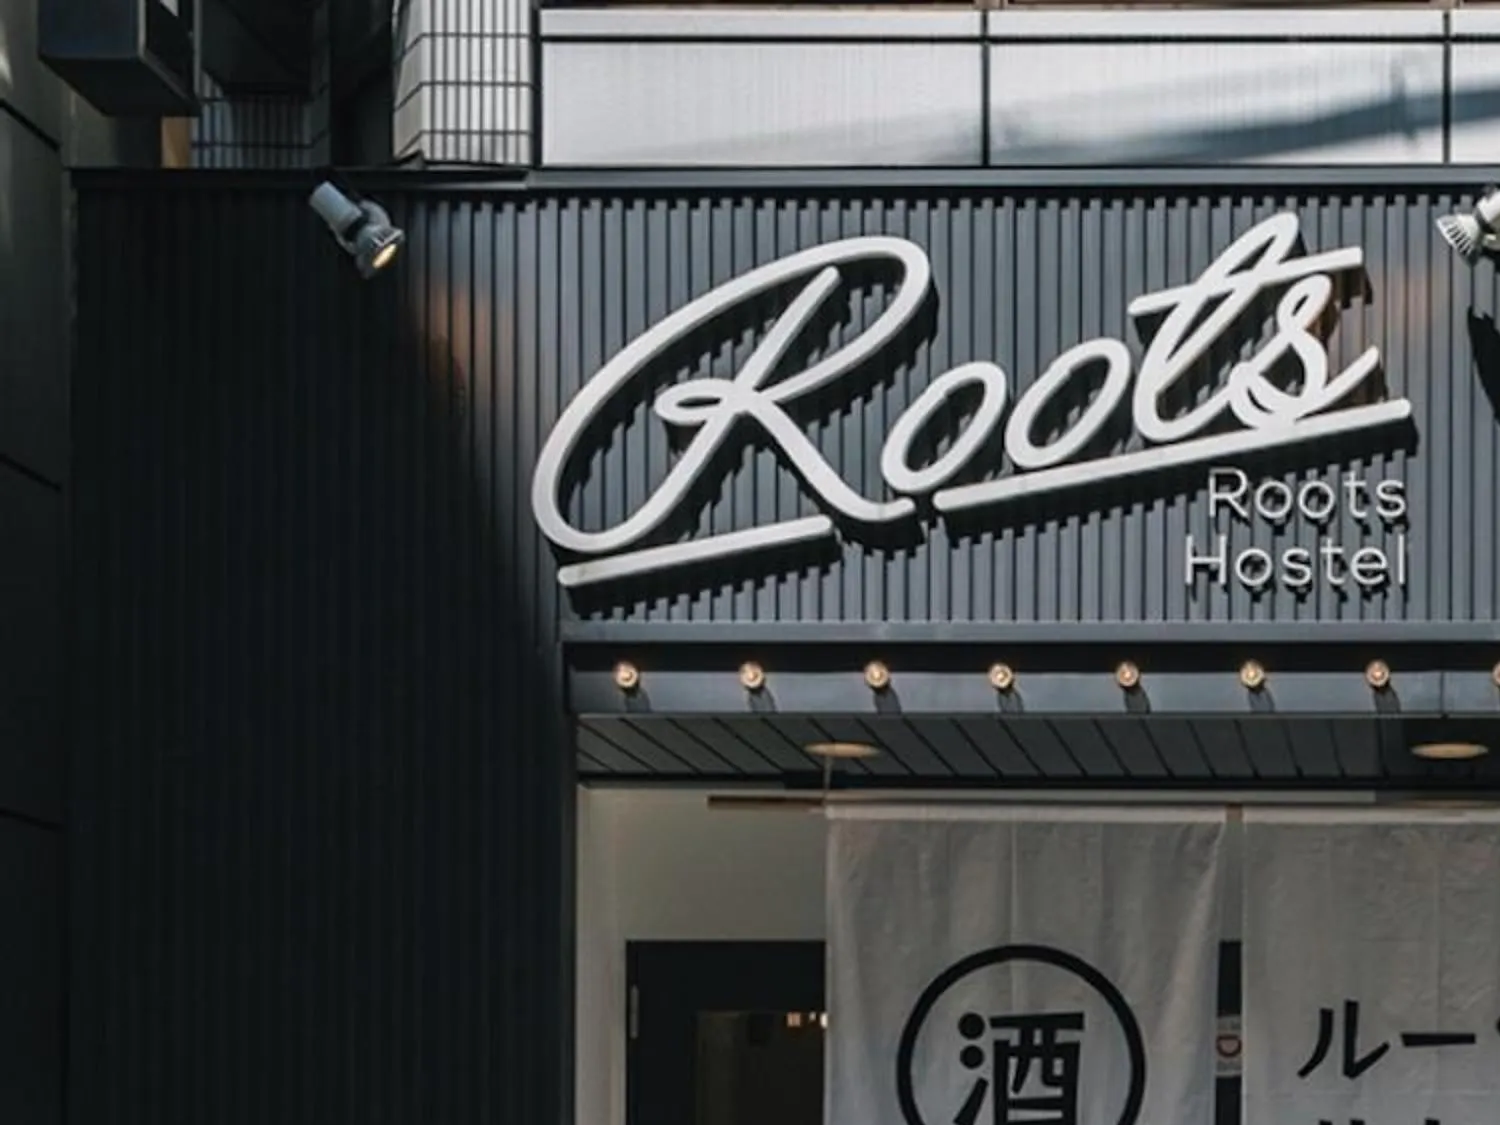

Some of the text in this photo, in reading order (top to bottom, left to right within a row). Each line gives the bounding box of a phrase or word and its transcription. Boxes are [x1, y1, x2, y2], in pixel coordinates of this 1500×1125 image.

[532, 211, 1380, 552] Roots
[1209, 469, 1406, 520] Roots
[1184, 533, 1406, 586] Hostel
